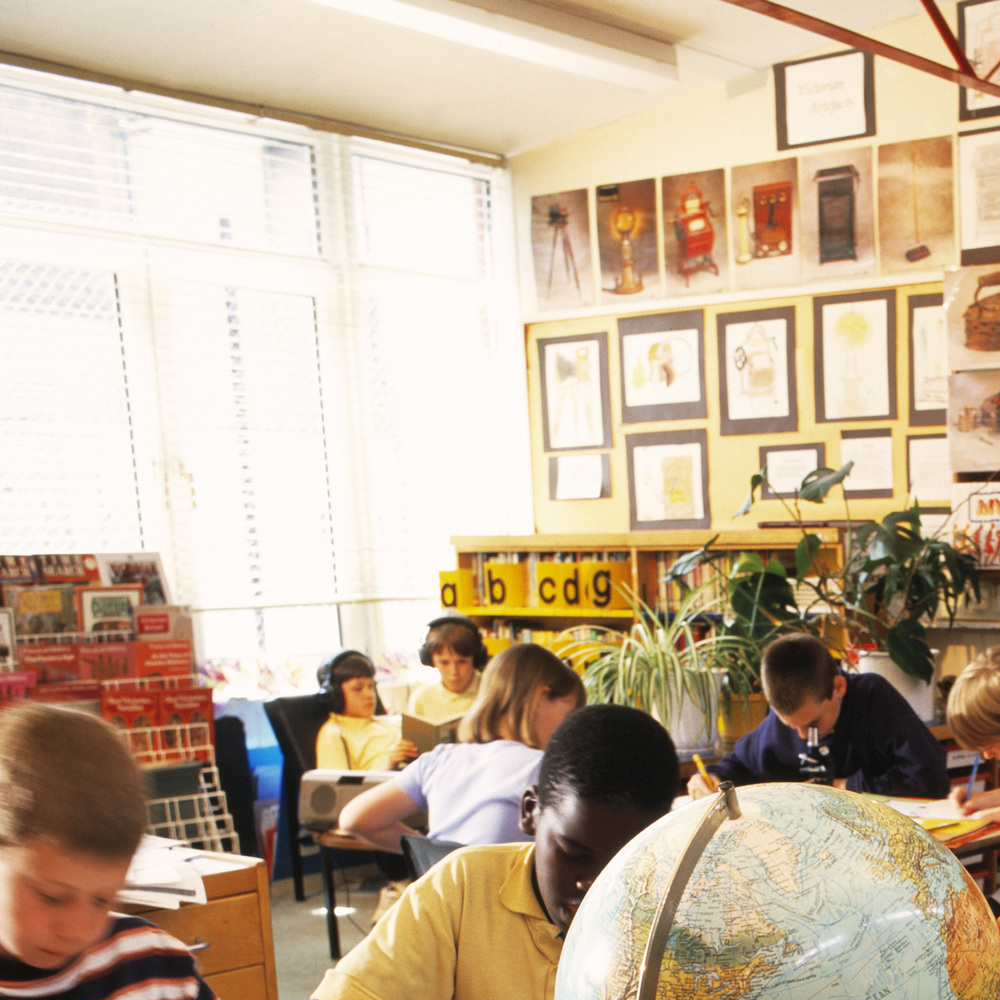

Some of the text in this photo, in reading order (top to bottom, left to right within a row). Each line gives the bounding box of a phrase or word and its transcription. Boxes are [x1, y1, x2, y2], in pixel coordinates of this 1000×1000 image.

[441, 568, 611, 607] a b c d g
